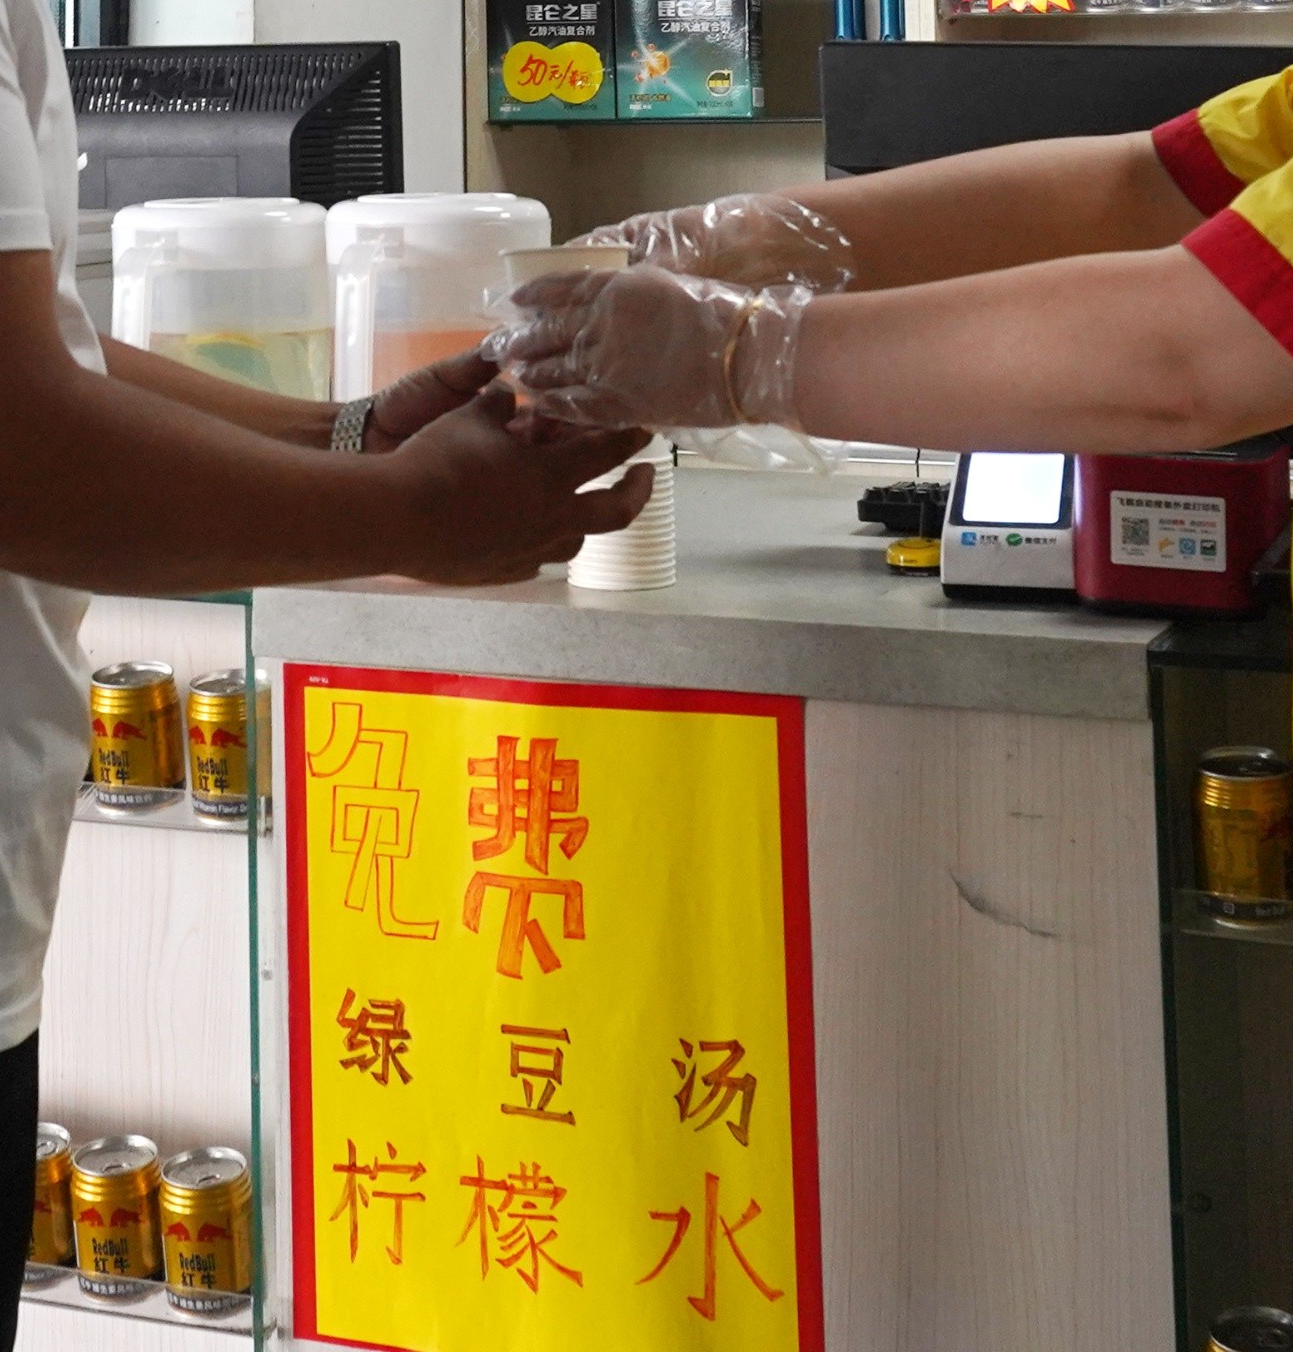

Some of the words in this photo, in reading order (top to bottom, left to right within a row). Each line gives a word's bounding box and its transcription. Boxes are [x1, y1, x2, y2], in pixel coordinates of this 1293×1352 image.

[525, 3, 599, 22] 昆仑之星
[528, 25, 596, 37] 乙醇汽油复合剂
[336, 987, 758, 1148] 绿豆汤
[329, 1136, 785, 1323] 柠檬水
